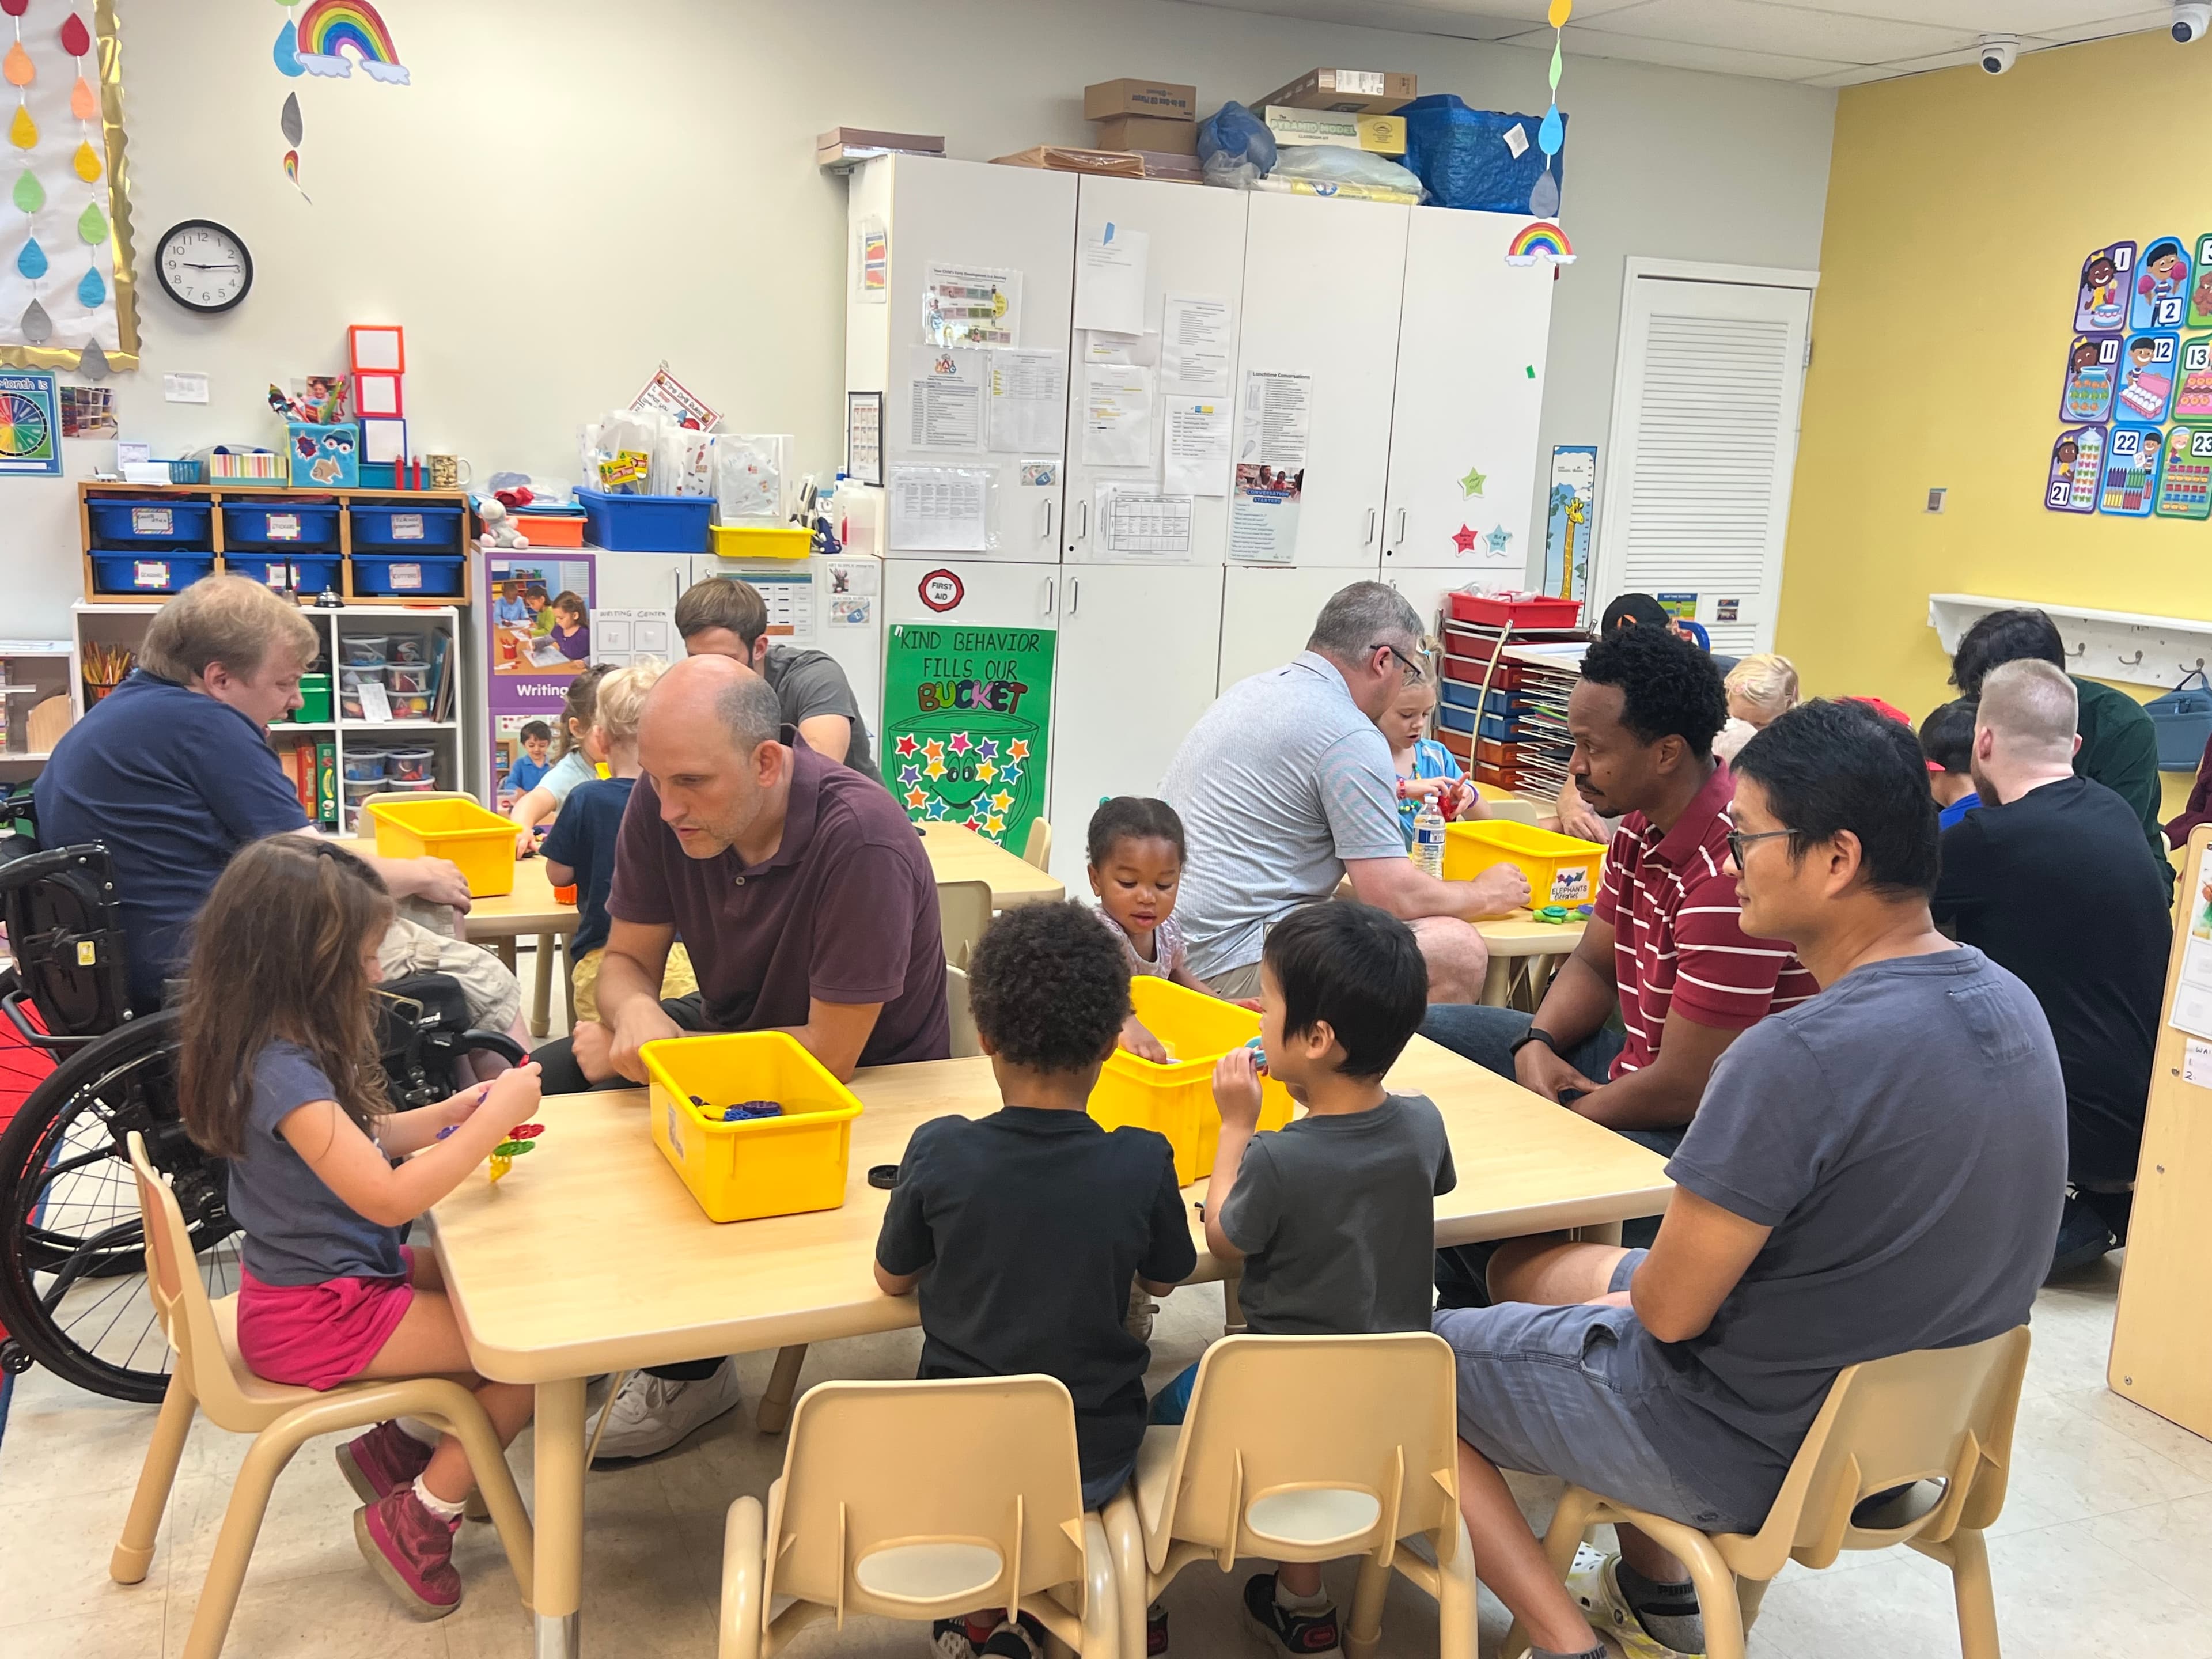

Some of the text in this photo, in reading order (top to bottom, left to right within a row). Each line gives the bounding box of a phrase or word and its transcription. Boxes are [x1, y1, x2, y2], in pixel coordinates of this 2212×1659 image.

[1271, 118, 1357, 137] PYRAMID MODEL
[183, 235, 192, 245] 11
[198, 232, 209, 241] 12
[173, 246, 185, 255] 10
[228, 249, 234, 259] 2
[2120, 251, 2125, 267] 1
[168, 260, 176, 270] 9
[234, 264, 240, 274] 3
[174, 275, 182, 284] 8
[229, 279, 236, 287] 4
[186, 287, 194, 296] 7
[202, 291, 210, 301] 6
[218, 289, 225, 297] 5
[2165, 302, 2175, 319] 2
[2103, 343, 2115, 360] 11
[2156, 342, 2171, 358] 12
[2190, 349, 2207, 366] 13
[38, 379, 48, 391] is
[677, 392, 690, 404] Drill
[2116, 435, 2136, 450] 22
[2194, 436, 2212, 452] 23
[2052, 486, 2067, 502] 21
[931, 582, 953, 590] FIRST
[934, 592, 948, 601] AID
[600, 609, 632, 618] WRITING
[900, 631, 1040, 652] KIND BEHAVIOR
[924, 658, 1018, 680] FILLS OUR
[517, 683, 569, 698] Writing
[918, 679, 1028, 714] BUCKET
[1552, 885, 1588, 895] ELEPHANTS
